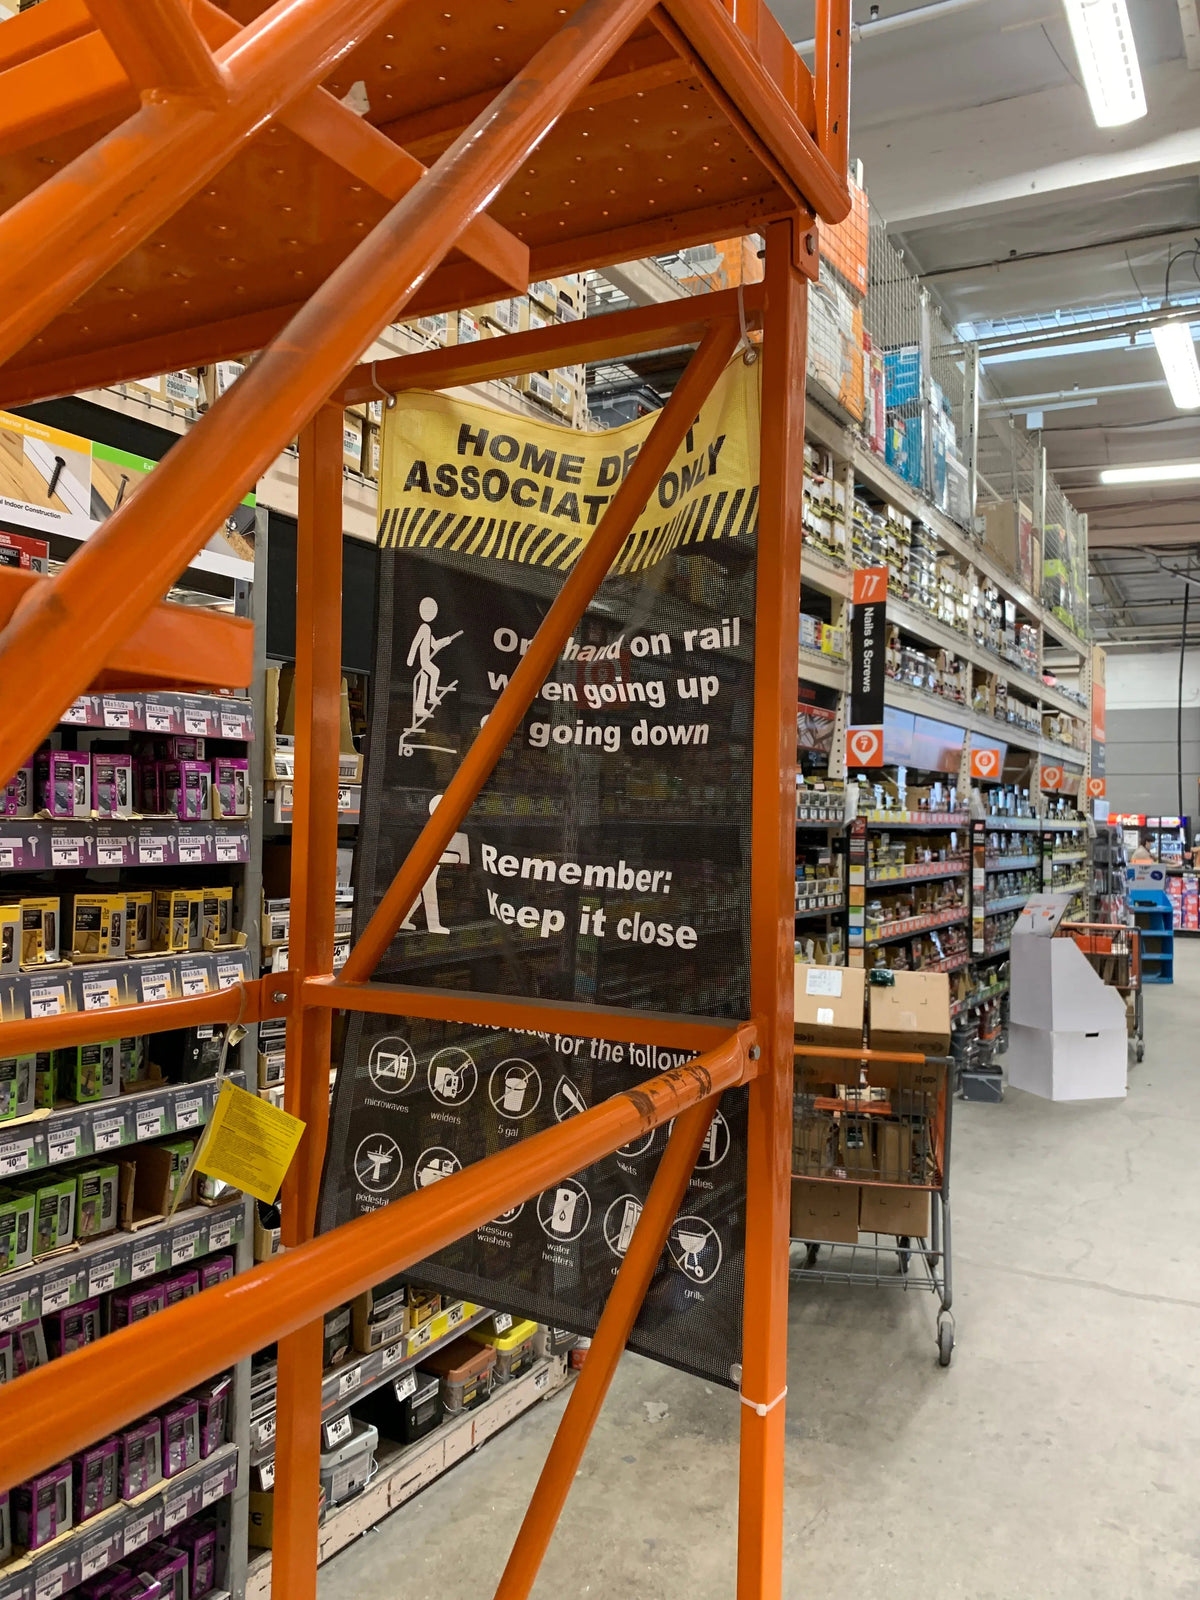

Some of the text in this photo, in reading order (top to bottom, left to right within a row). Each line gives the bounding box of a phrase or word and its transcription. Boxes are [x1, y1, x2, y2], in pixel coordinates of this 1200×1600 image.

[457, 413, 700, 488] HOME DET
[403, 434, 726, 526] ASSOCIAT ONLY
[5, 499, 23, 509] Indoor
[25, 505, 61, 519] Construction
[493, 616, 740, 662] On hand on rail
[862, 606, 875, 693] Nails & Screws
[487, 671, 719, 709] wen going up
[528, 719, 709, 753] going down
[481, 843, 673, 894] Remember:
[487, 888, 698, 949] Keep it close
[554, 1033, 584, 1056] for
[591, 1038, 624, 1062] the
[364, 1096, 409, 1113] microwaves
[430, 1111, 461, 1125] welders
[497, 1124, 519, 1137] 5 gal
[690, 1178, 713, 1190] nities
[355, 1193, 390, 1206] pedestal
[477, 1226, 513, 1239] pressure
[477, 1233, 511, 1249] washers
[546, 1243, 570, 1255] water
[542, 1251, 574, 1267] heaters
[684, 1288, 705, 1302] grills
